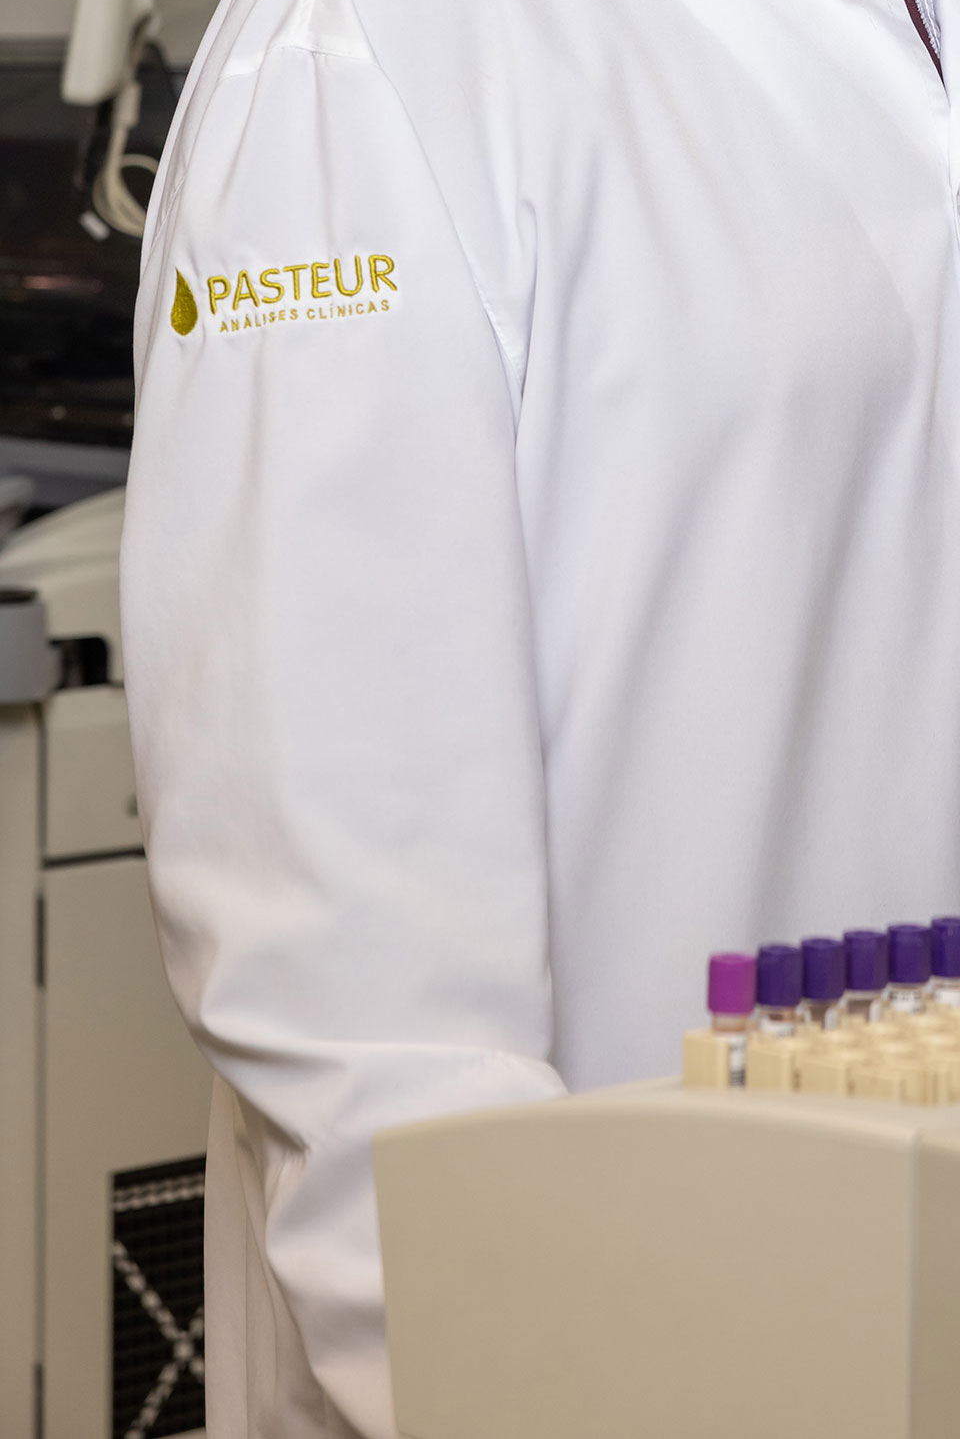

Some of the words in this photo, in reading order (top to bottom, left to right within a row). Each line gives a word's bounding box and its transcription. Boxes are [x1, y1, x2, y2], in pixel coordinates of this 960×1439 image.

[207, 254, 398, 315] PASTEUR
[219, 308, 299, 333] ANÁLISES
[306, 299, 390, 321] CLÍNICAS
